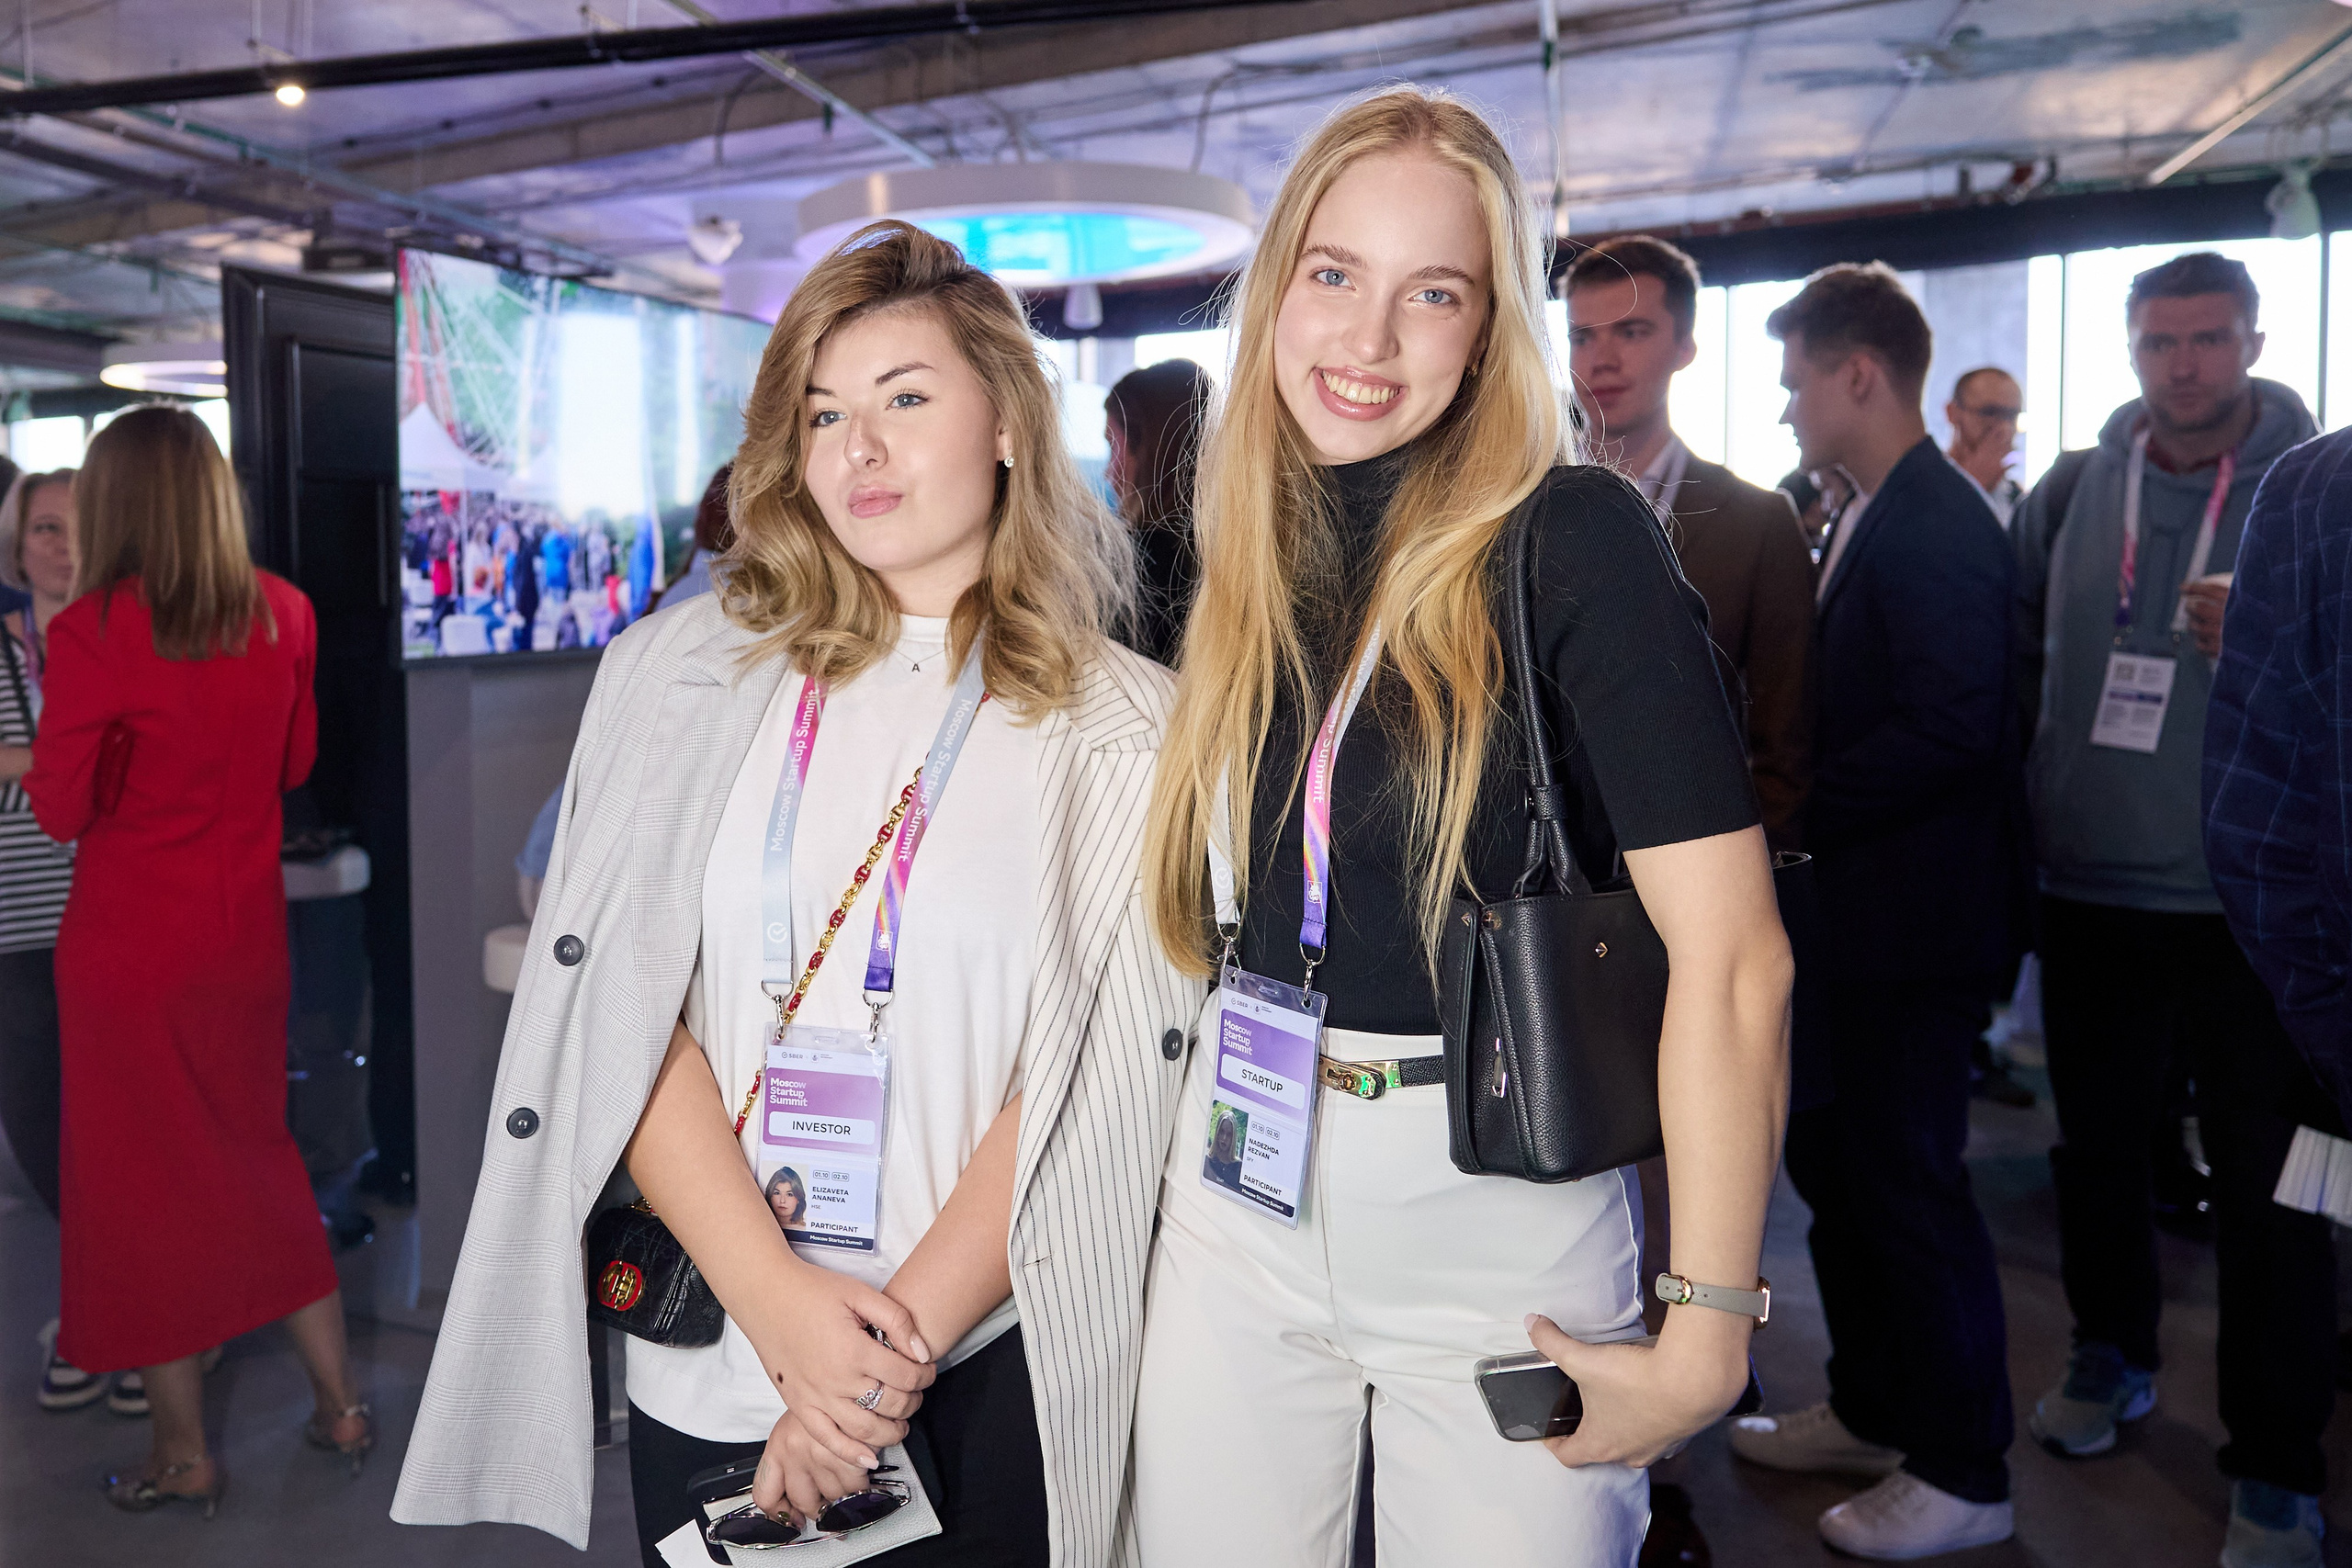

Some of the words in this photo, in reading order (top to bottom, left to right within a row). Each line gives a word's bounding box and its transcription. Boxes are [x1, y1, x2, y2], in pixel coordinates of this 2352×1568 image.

[911, 663, 921, 672] A
[942, 699, 973, 749] Moscow
[770, 795, 792, 852] Moscow
[783, 740, 808, 791] Startup
[796, 688, 820, 738] Summit
[919, 751, 952, 805] Startup
[1313, 738, 1331, 803] Summit
[898, 807, 927, 862] Summit
[1224, 1018, 1252, 1037] Moscow
[1223, 1027, 1250, 1047] Startup
[1223, 1036, 1253, 1055] Summit
[770, 1077, 807, 1089] Moscow
[1241, 1068, 1283, 1093] STARTUP
[769, 1094, 808, 1107] Summit
[770, 1086, 805, 1099] Startup
[792, 1120, 851, 1135] INVESTOR
[1248, 1145, 1270, 1160] REZVAN
[1249, 1138, 1280, 1156] NADEZHDA
[833, 1173, 848, 1181] 02.10
[1243, 1174, 1282, 1196] PARTICIPANT
[811, 1194, 846, 1203] ANANEVA
[812, 1186, 850, 1196] ELIZAVETA
[810, 1222, 859, 1233] PARTICIPANT
[828, 1236, 846, 1245] Startup
